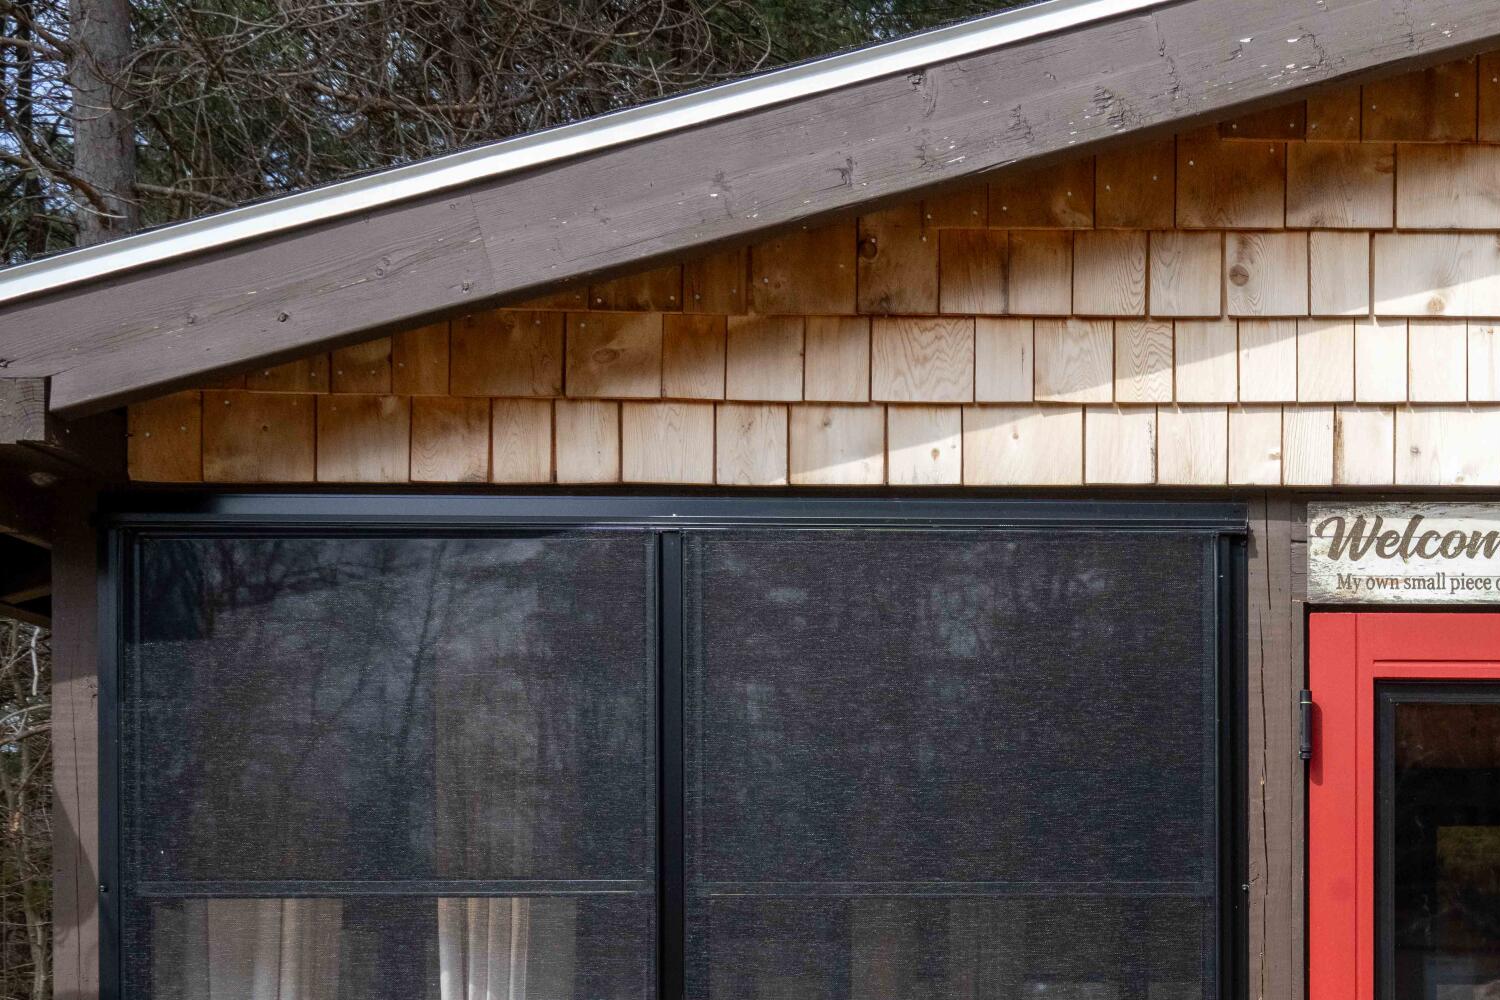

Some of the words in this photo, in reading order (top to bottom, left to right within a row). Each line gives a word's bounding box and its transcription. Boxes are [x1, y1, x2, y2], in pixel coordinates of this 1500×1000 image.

[1336, 573, 1361, 595] My
[1366, 577, 1400, 590] own
[1404, 572, 1446, 590] small
[1450, 573, 1491, 594] piece
